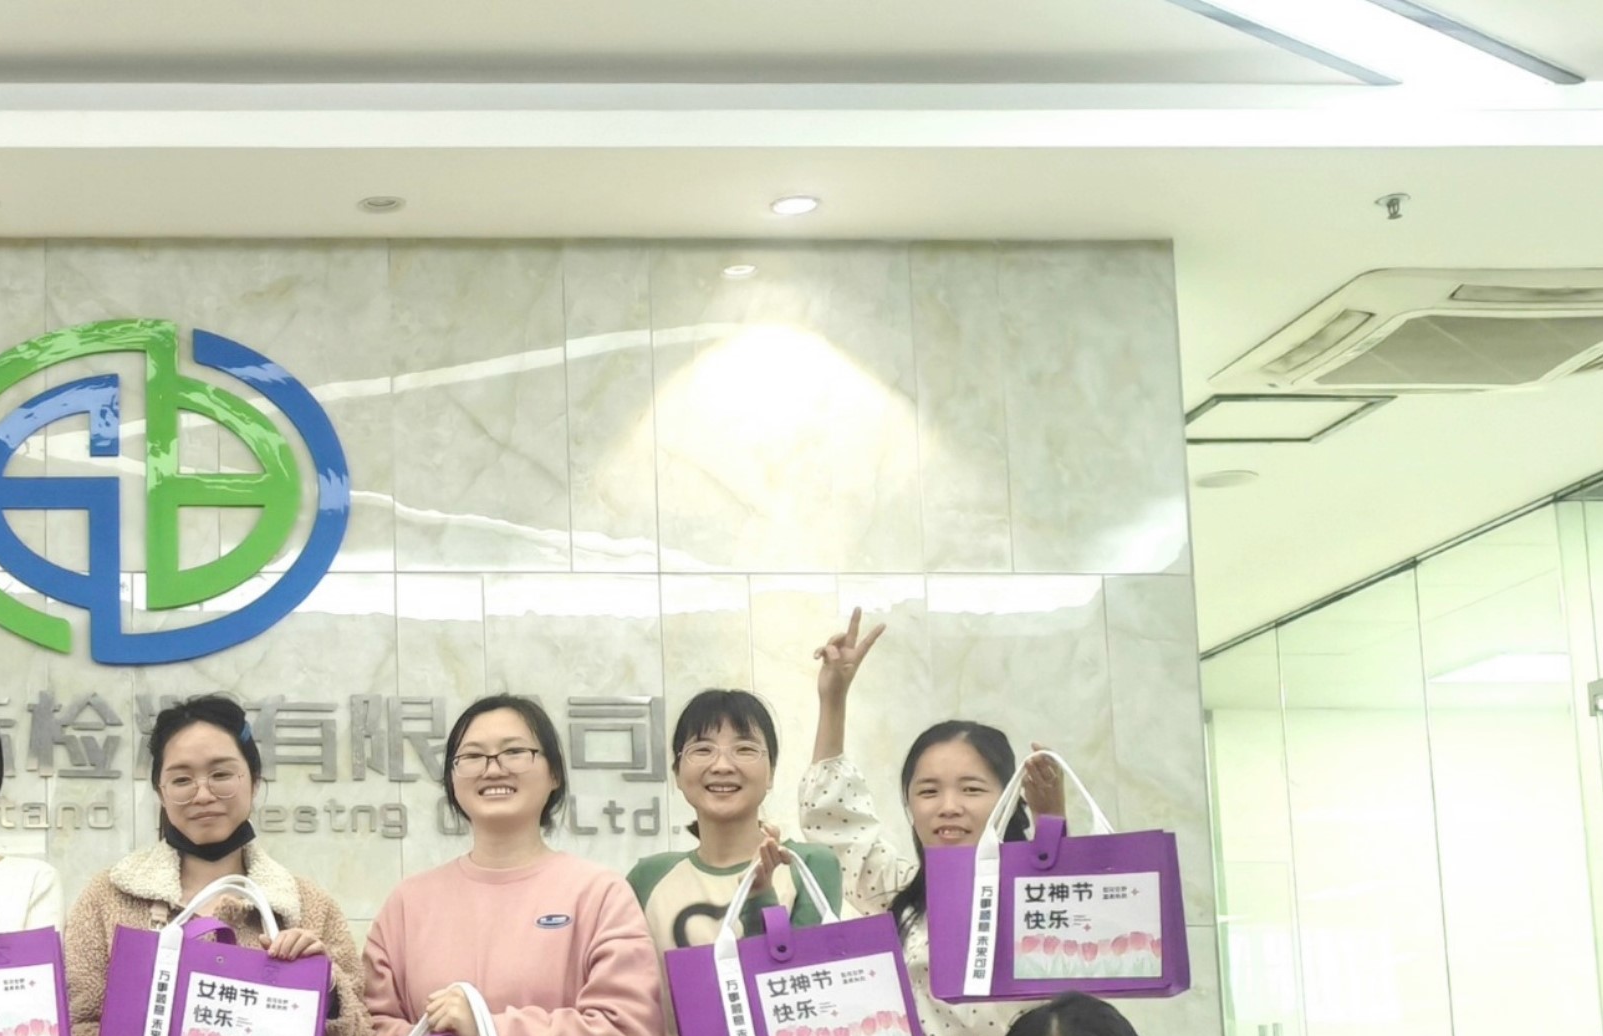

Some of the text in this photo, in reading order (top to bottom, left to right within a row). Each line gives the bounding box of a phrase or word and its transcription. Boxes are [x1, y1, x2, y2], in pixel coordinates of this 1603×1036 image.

[1025, 883, 1093, 903] 女神节
[1024, 910, 1069, 930] 快乐
[197, 980, 259, 1006] 女神节
[768, 970, 832, 997] 女神节
[194, 1005, 233, 1028] 快乐
[773, 999, 819, 1024] 快乐
